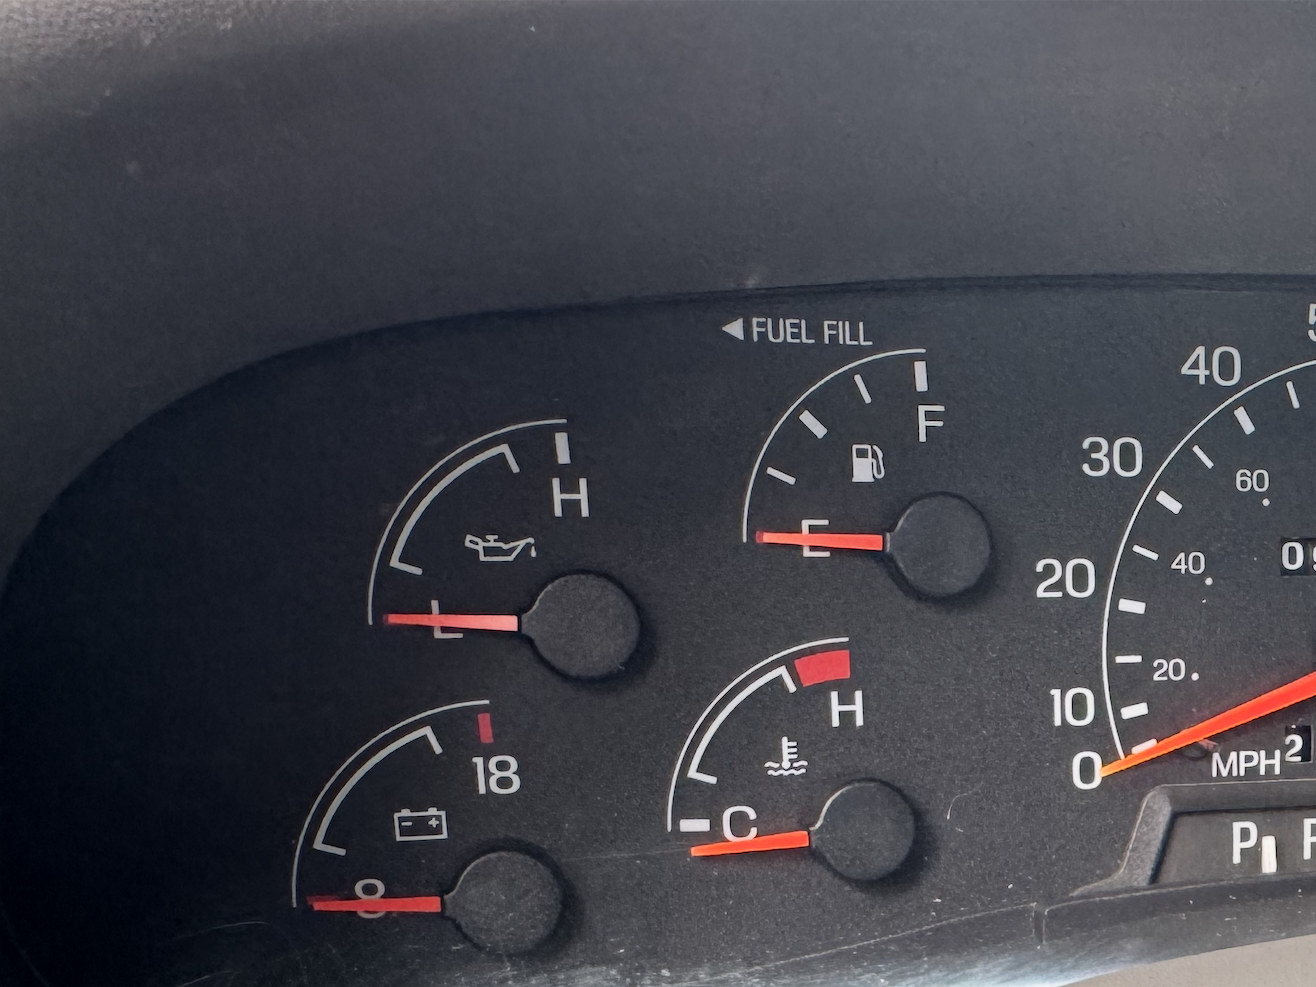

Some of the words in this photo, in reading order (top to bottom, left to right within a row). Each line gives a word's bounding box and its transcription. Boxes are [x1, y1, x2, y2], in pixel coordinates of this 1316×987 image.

[751, 316, 816, 344] FUEL
[823, 320, 873, 346] FILL
[1180, 345, 1242, 387] 40
[917, 404, 946, 443] F
[1081, 436, 1143, 478] 30
[551, 477, 590, 518] H
[1235, 468, 1270, 493] 60
[801, 519, 831, 558] E
[1035, 558, 1096, 599] 20
[1170, 551, 1206, 575] 40
[431, 599, 465, 639] L
[1152, 657, 1186, 682] 20
[830, 690, 864, 728] H
[1049, 686, 1095, 727] 10
[471, 754, 521, 795] 18
[1071, 752, 1103, 790] 0
[1211, 749, 1281, 778] MPH
[722, 805, 758, 842] C
[1232, 820, 1258, 865] P
